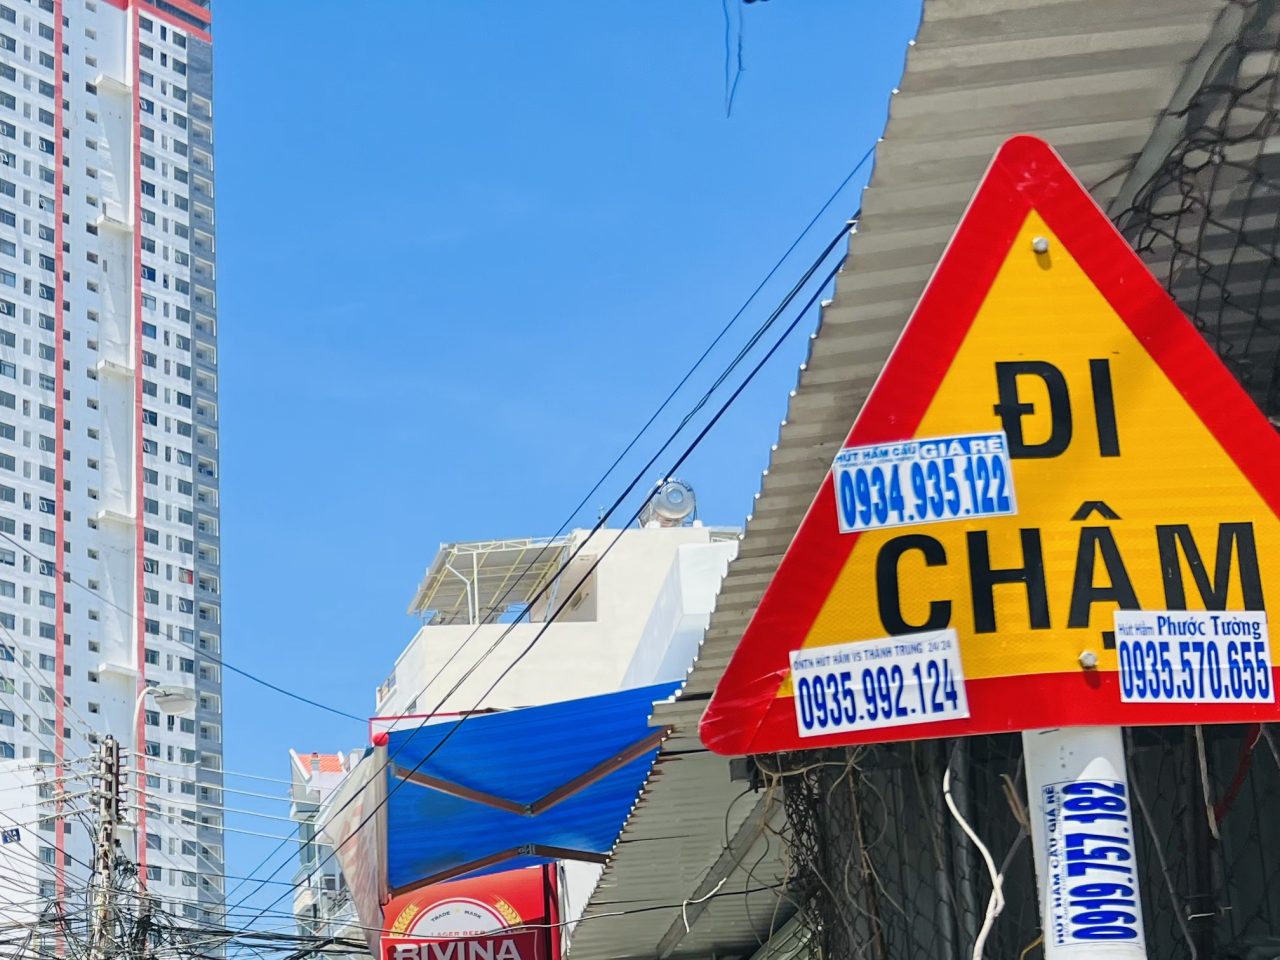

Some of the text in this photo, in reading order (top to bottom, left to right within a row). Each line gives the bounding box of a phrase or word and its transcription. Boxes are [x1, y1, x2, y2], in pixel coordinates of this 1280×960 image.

[993, 358, 1121, 459] ĐI
[920, 438, 966, 459] GIÁ
[840, 454, 1010, 528] 0934.935.122
[876, 500, 1266, 650] CHẬM
[1157, 615, 1206, 636] Phước
[1210, 615, 1262, 640] Tường
[798, 658, 958, 730] 0935.992.124
[1120, 640, 1270, 699] 0935.570.655
[1062, 781, 1138, 940] 0919.757.182
